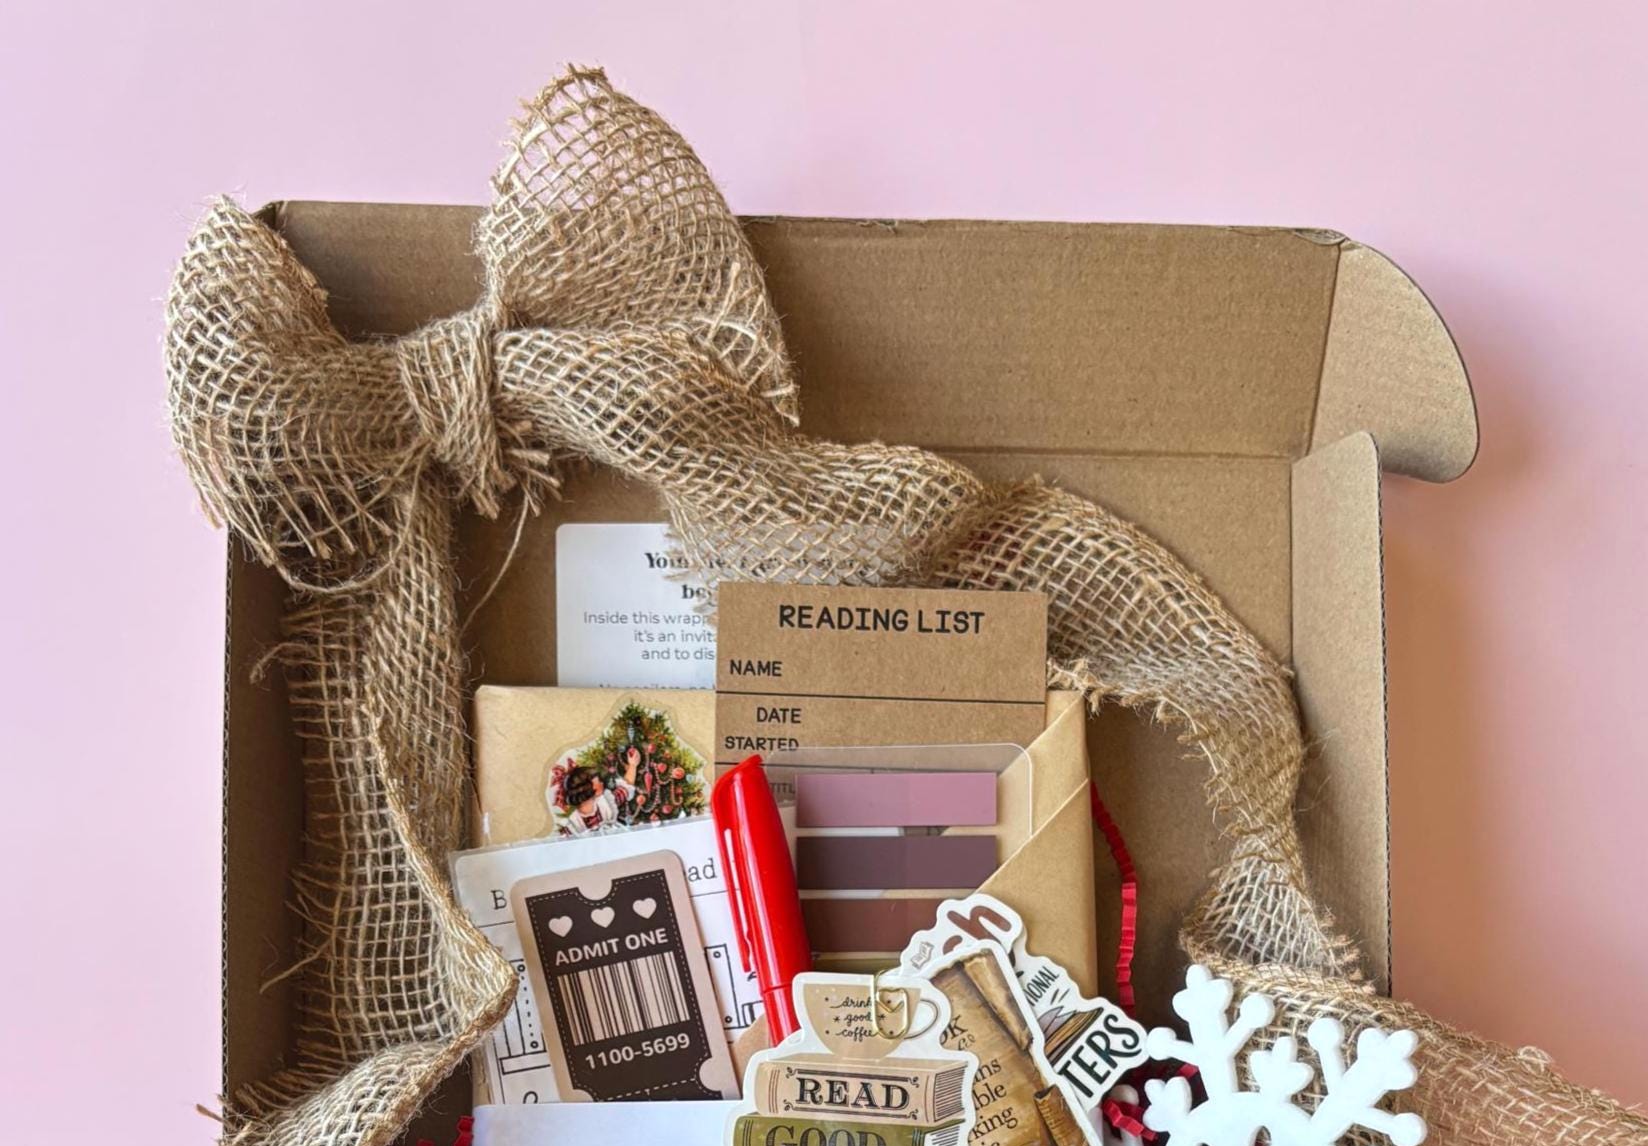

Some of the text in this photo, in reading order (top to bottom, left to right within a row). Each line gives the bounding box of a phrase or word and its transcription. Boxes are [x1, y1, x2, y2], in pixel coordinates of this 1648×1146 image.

[583, 612, 628, 625] Inside
[632, 611, 660, 625] this
[779, 604, 985, 635] READING LIST
[634, 630, 717, 643] it's an invit
[641, 648, 716, 661] and to dis
[729, 659, 783, 677] NAME
[756, 706, 802, 724] DATE
[725, 735, 800, 752] STARTED
[769, 782, 796, 795] TITL
[688, 857, 718, 882] ad
[554, 927, 669, 967] ADMIT ONE
[584, 1032, 692, 1071] 1100-5699
[1057, 1013, 1143, 1099] TERS
[794, 1075, 911, 1113] READ
